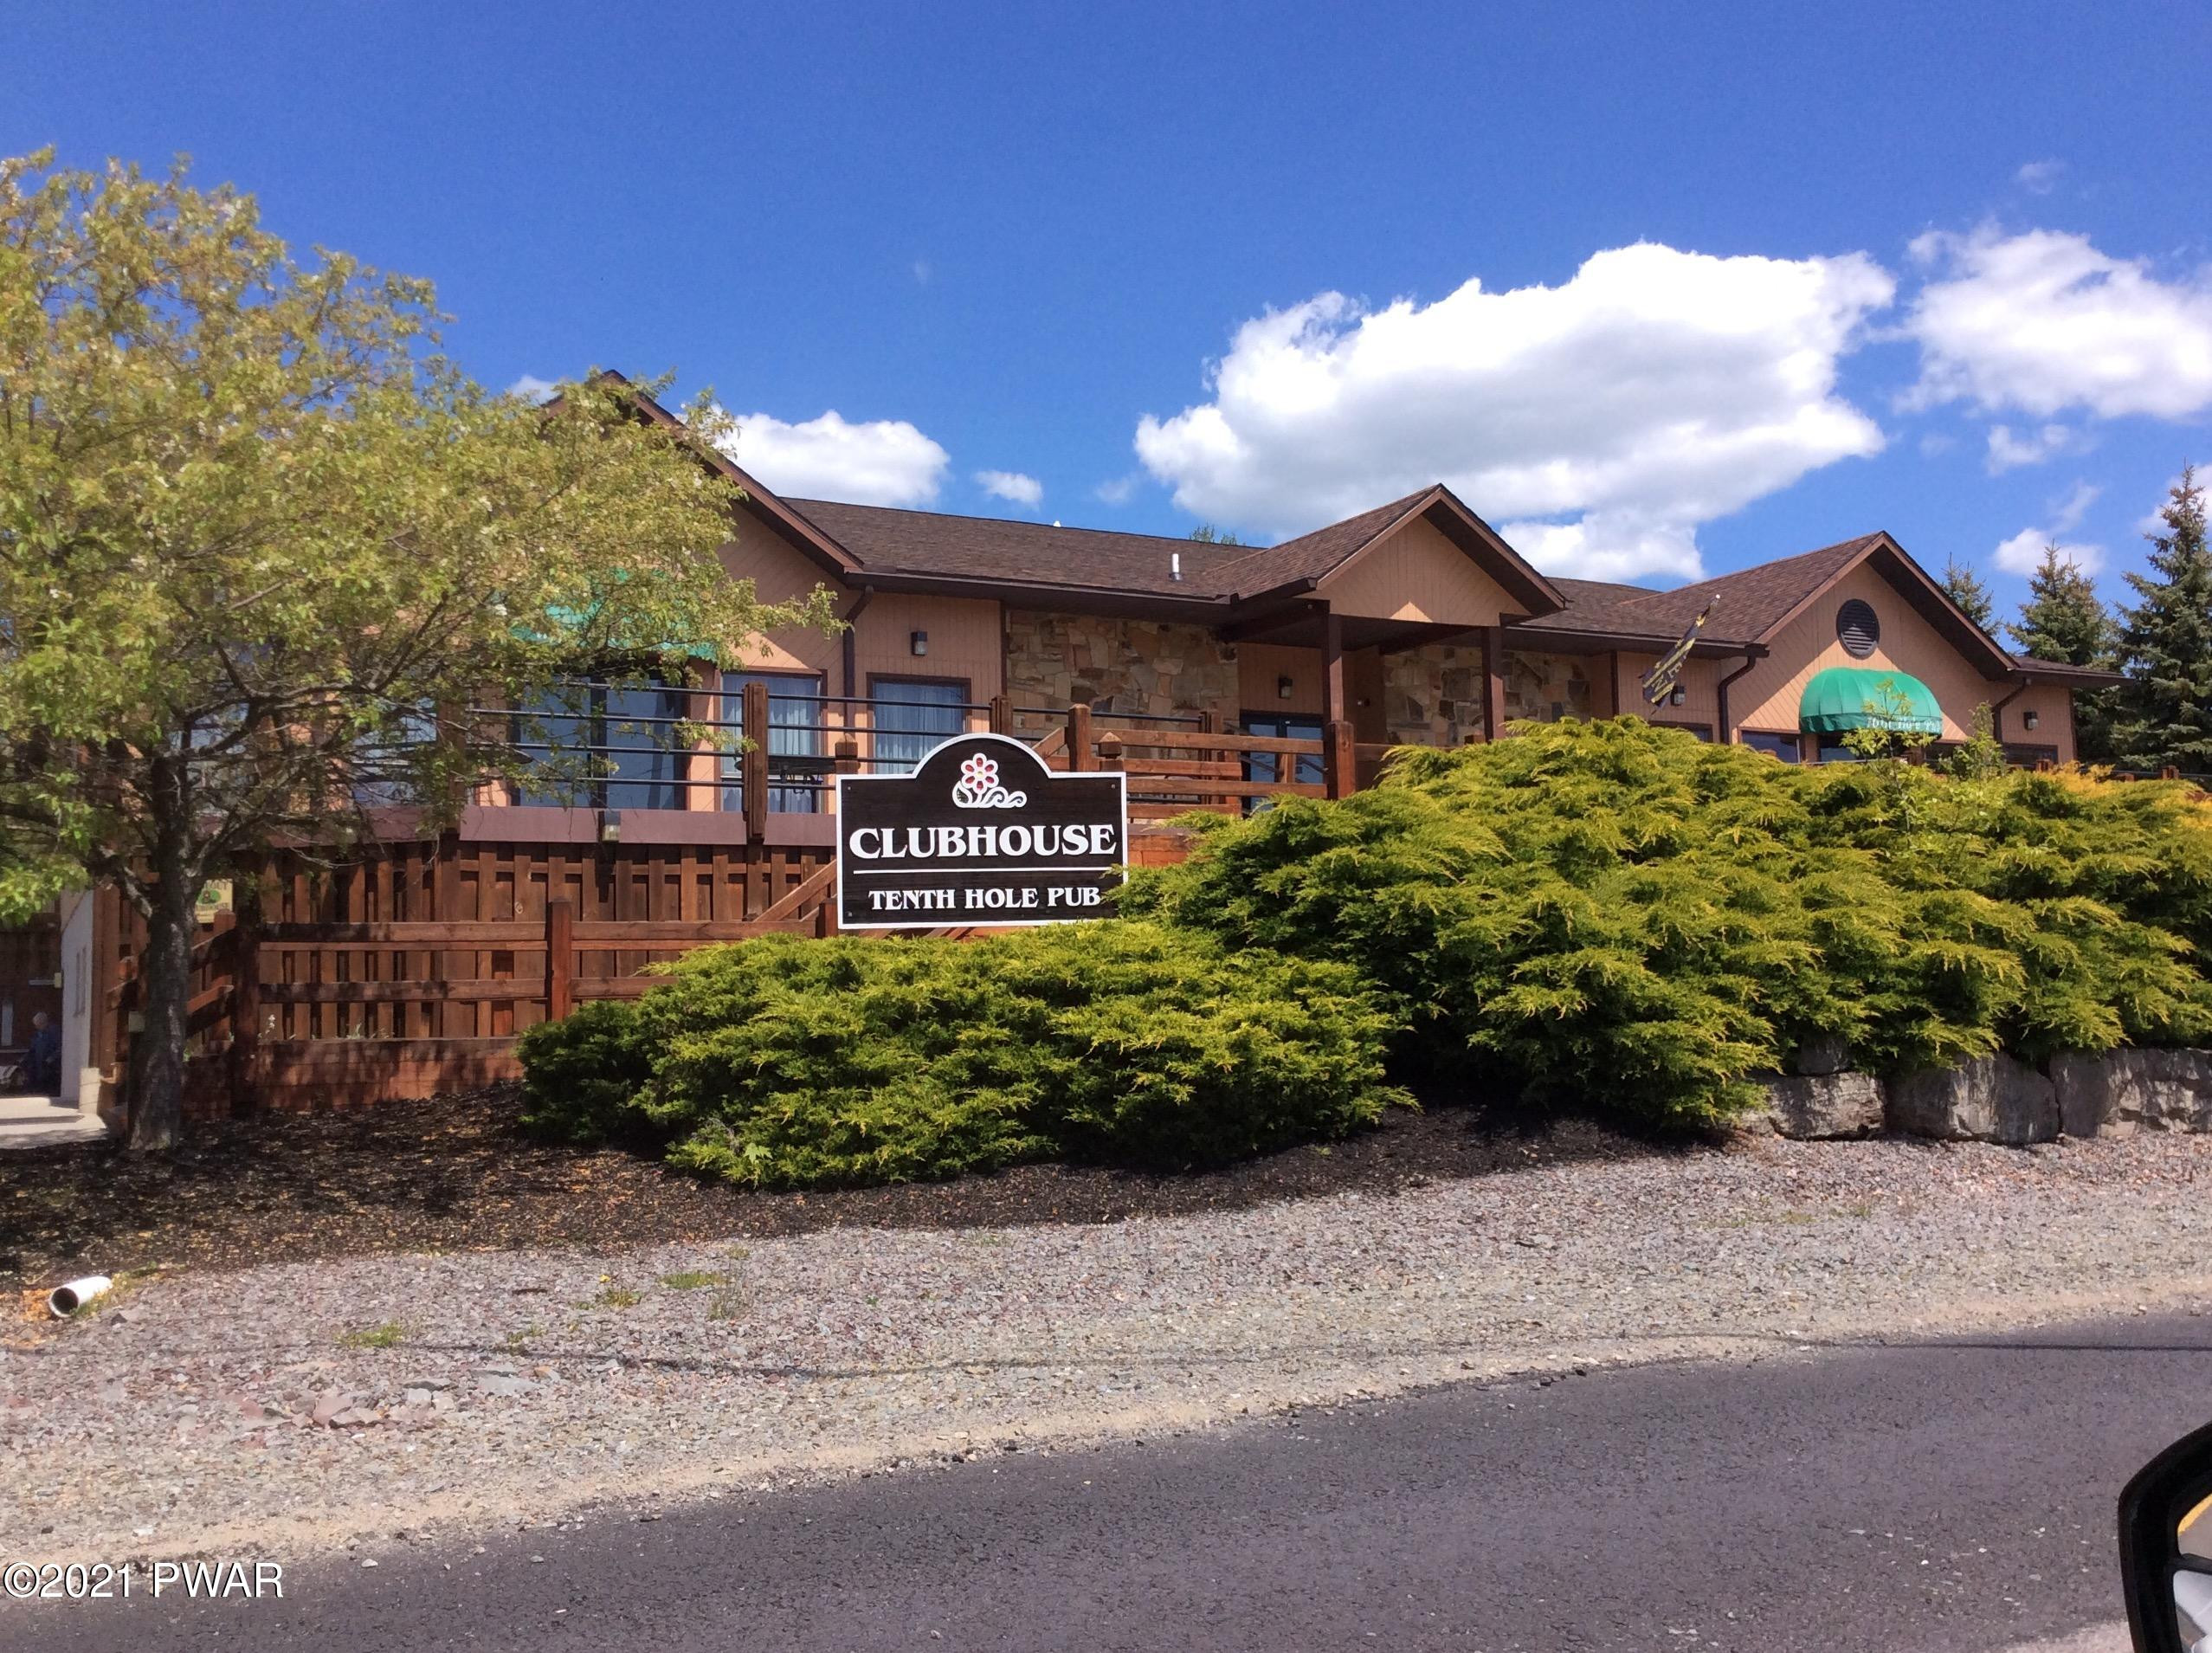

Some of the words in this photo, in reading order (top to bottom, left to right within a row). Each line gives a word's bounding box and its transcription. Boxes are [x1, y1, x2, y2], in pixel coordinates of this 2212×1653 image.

[849, 824, 1117, 859] CLUBHOUSE
[868, 889, 957, 911] TENTH
[964, 888, 1039, 909] HOLE
[1048, 888, 1101, 907] PUB
